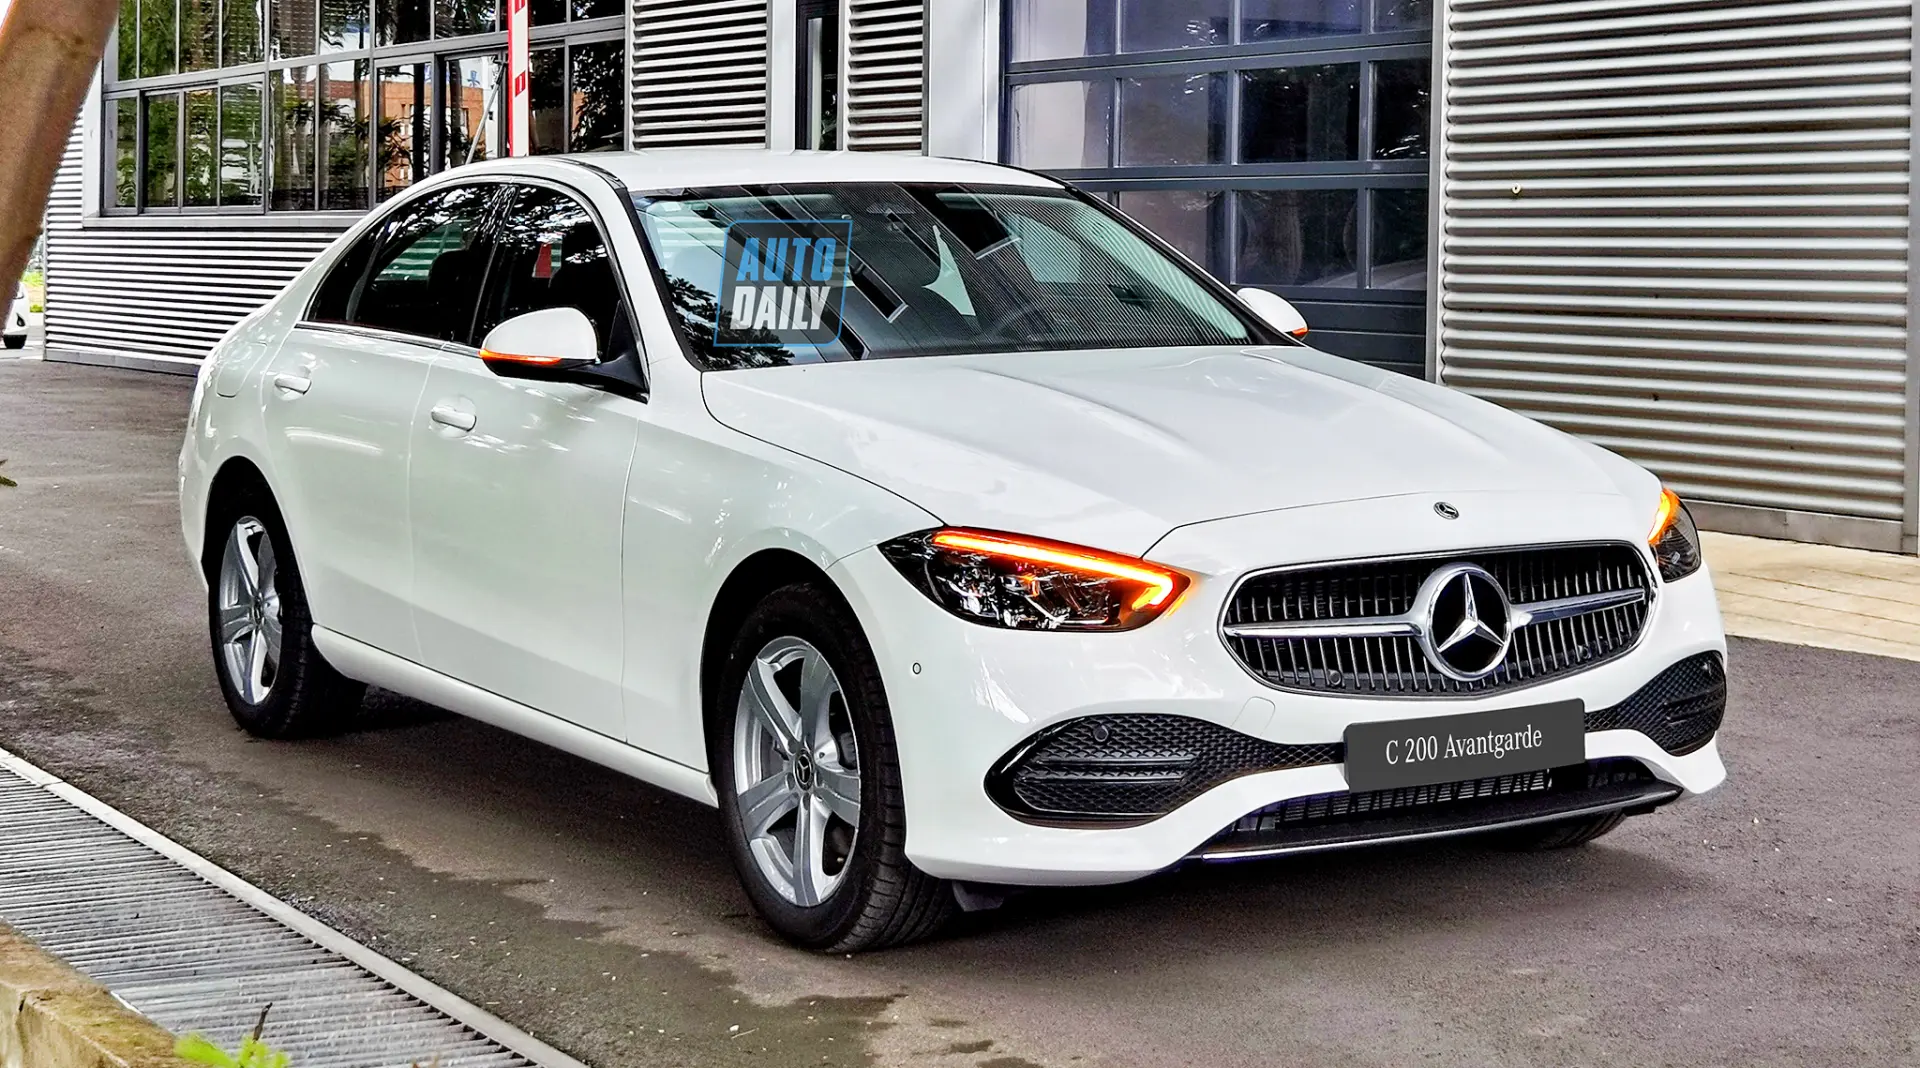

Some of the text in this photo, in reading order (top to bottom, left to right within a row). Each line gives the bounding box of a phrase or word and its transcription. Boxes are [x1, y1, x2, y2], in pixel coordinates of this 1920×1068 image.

[1386, 724, 1543, 765] C 200 Avantgarde
